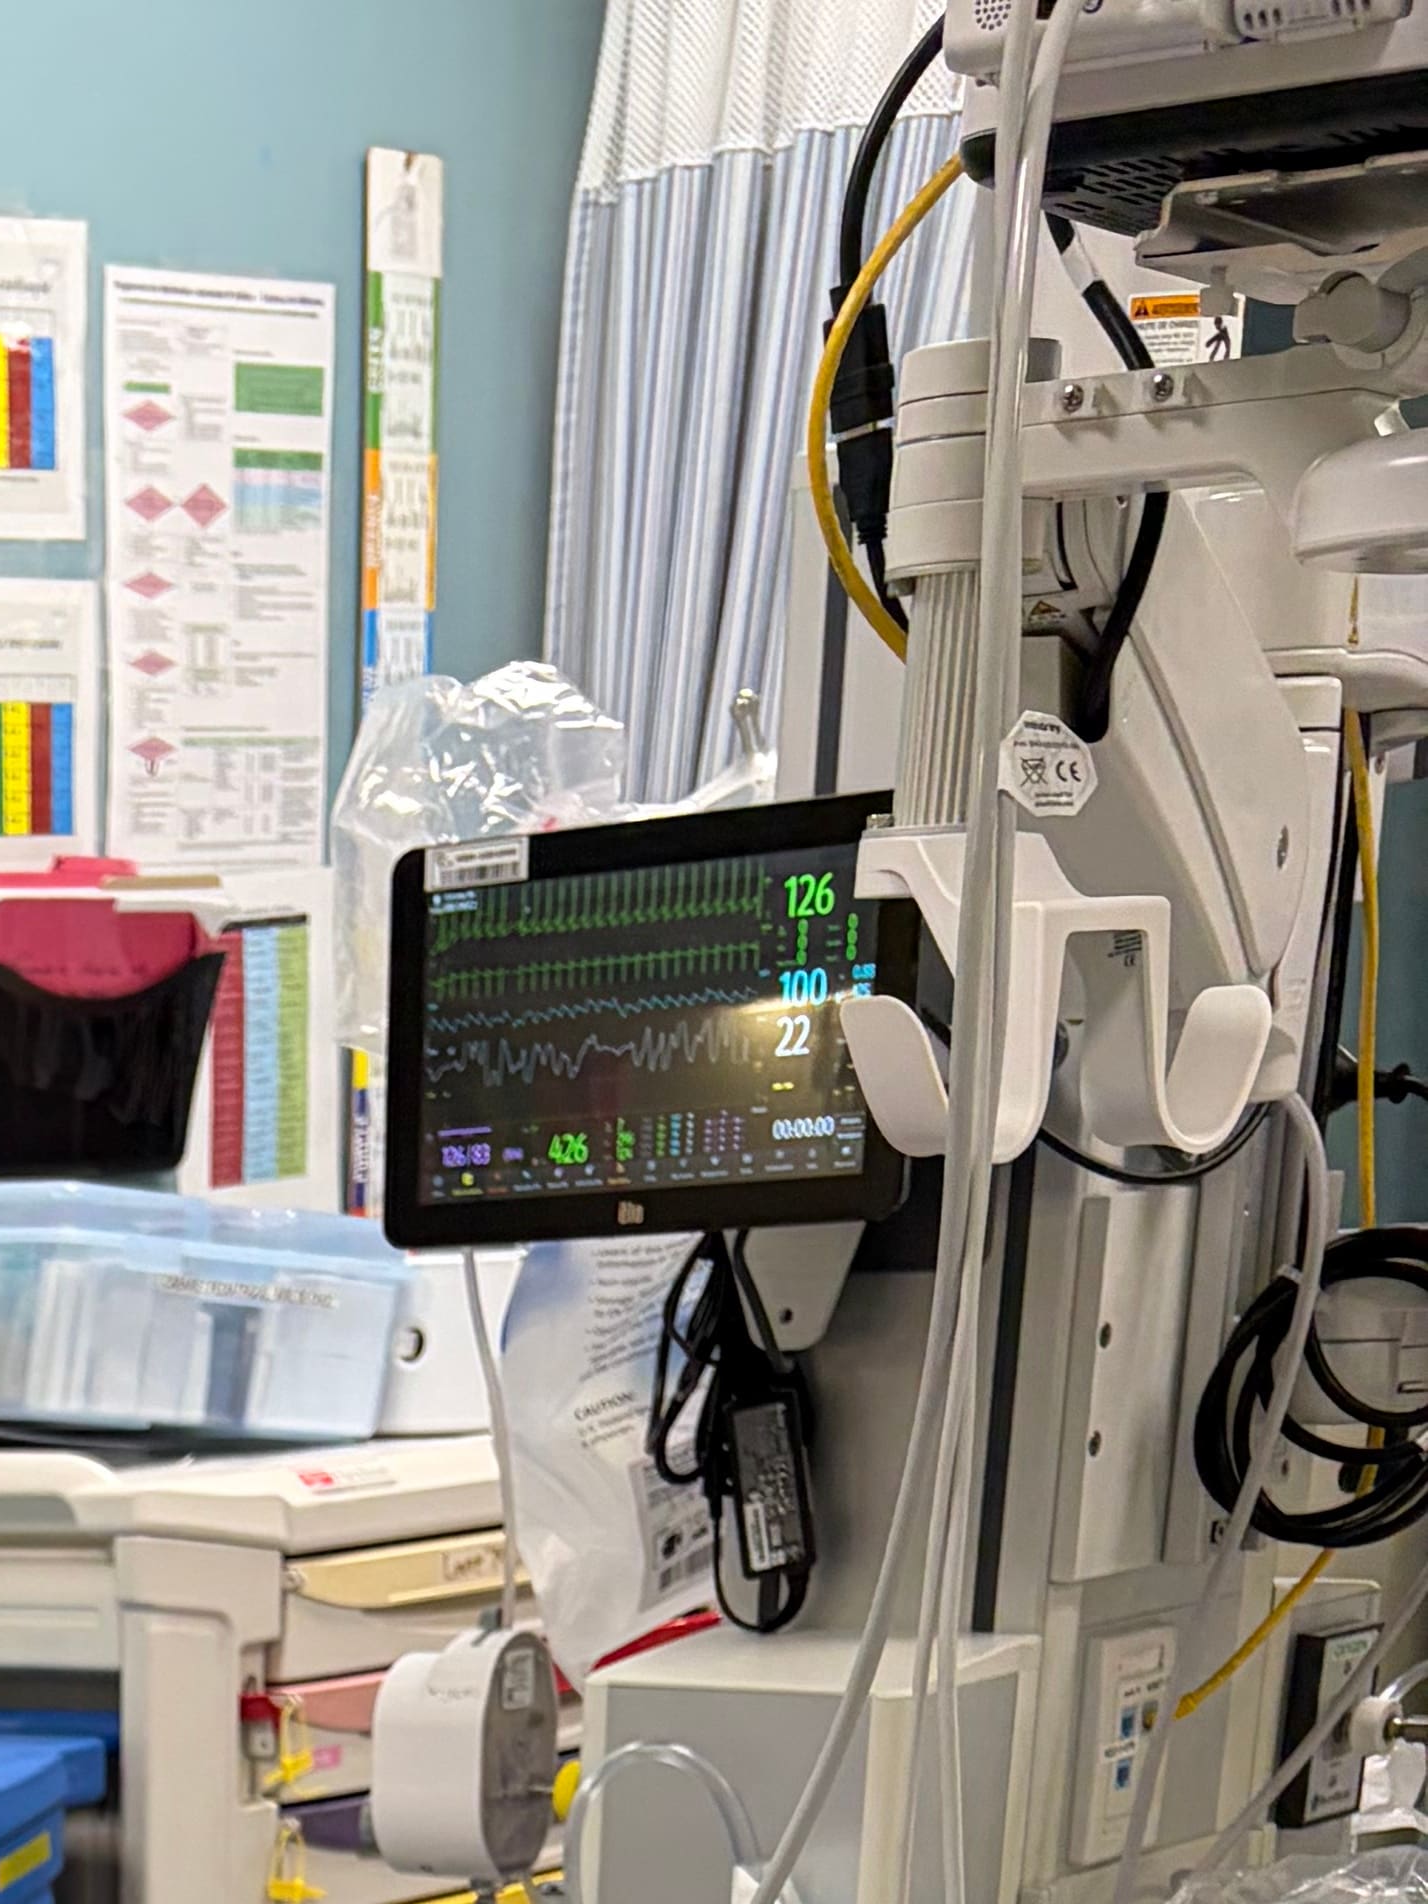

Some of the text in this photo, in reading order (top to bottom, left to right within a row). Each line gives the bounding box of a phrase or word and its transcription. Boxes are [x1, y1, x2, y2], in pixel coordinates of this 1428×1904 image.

[785, 872, 835, 918] 126
[779, 967, 828, 1007] 100
[775, 1014, 811, 1056] 22
